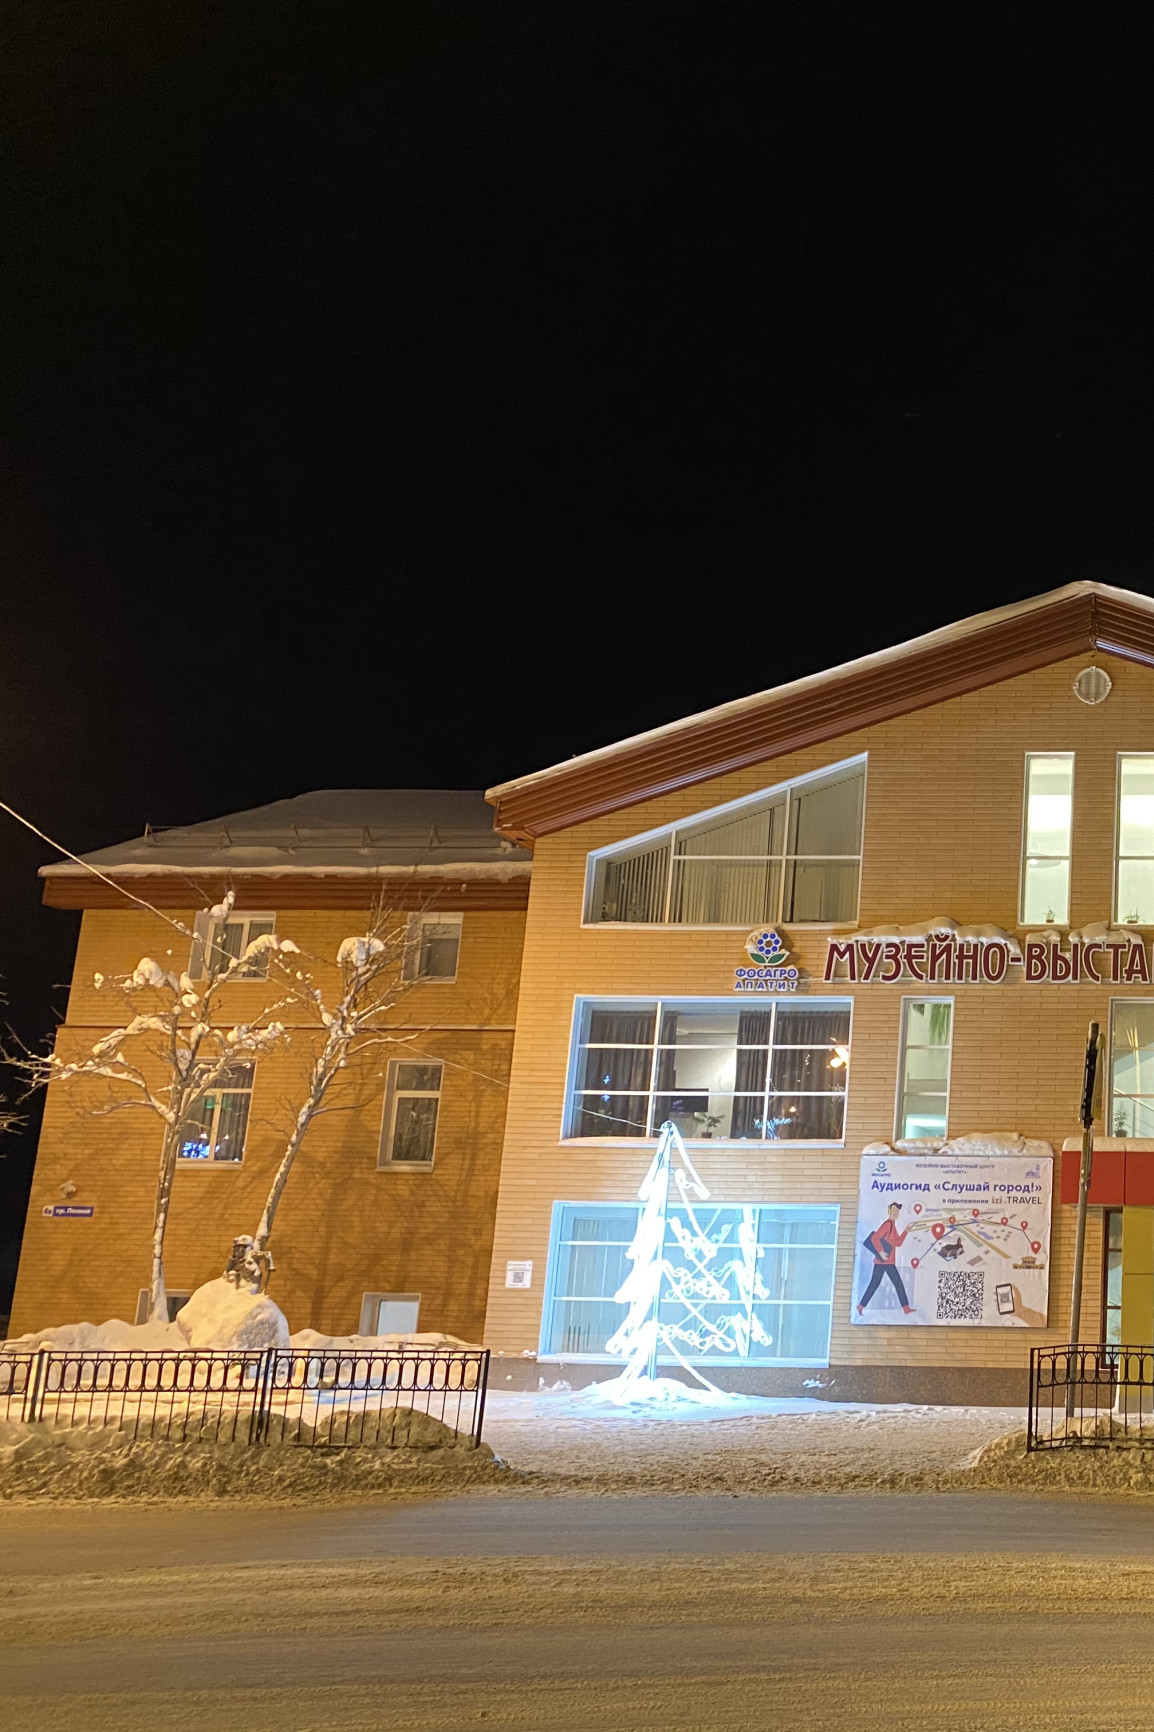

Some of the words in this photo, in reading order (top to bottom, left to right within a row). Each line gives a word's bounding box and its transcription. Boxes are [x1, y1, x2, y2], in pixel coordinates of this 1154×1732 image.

[735, 968, 797, 978] ФОСАГРО
[734, 981, 796, 990] АПАТИТ
[871, 1180, 930, 1192] Аудиогид
[934, 1181, 990, 1193] «Слушай
[993, 1182, 1042, 1194] город!»
